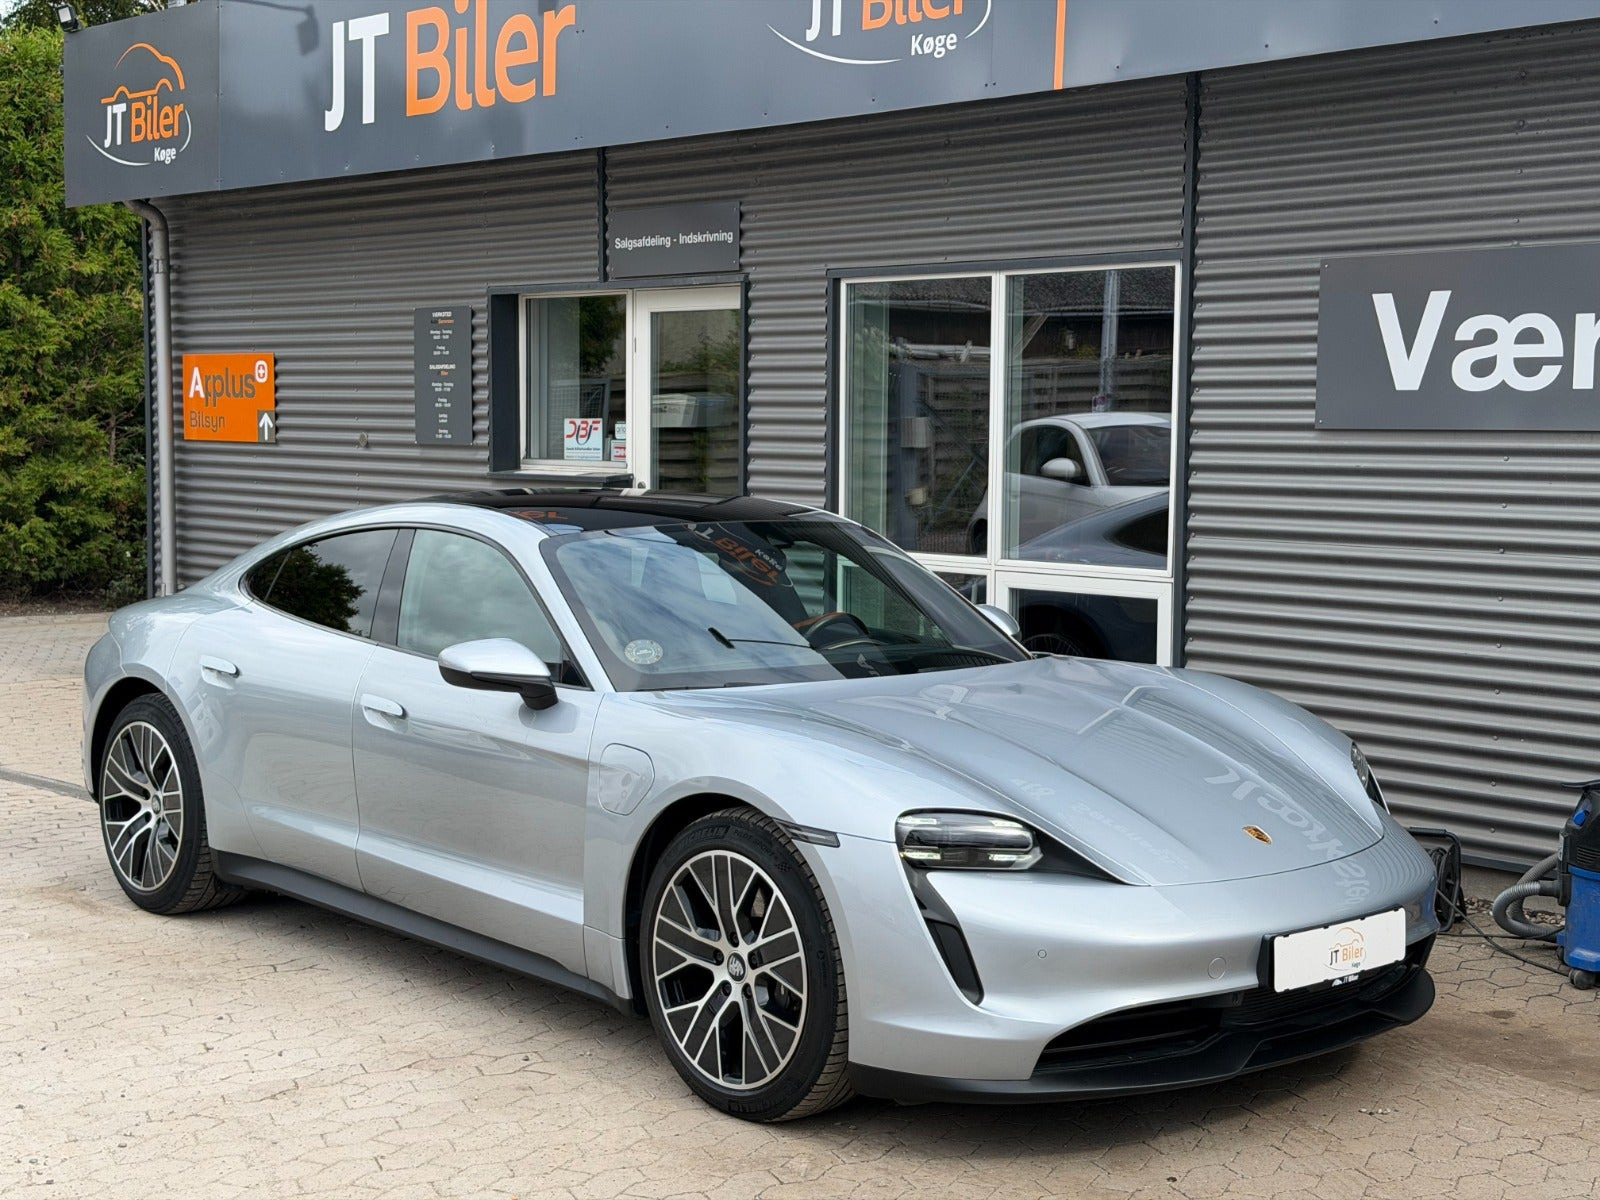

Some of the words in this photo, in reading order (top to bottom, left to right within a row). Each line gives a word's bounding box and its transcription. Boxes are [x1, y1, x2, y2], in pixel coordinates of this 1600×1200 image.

[911, 33, 957, 58] Køge
[325, 13, 389, 131] JT
[406, 0, 575, 116] Biler
[104, 103, 126, 148] JT
[131, 95, 184, 142] Biler
[154, 147, 176, 164] Køge
[615, 236, 671, 250] Salgsafdeling
[680, 230, 733, 244] Indskrivning
[190, 411, 225, 432] Bilsyn
[1330, 949, 1339, 966] JT
[1342, 946, 1364, 961] Biler
